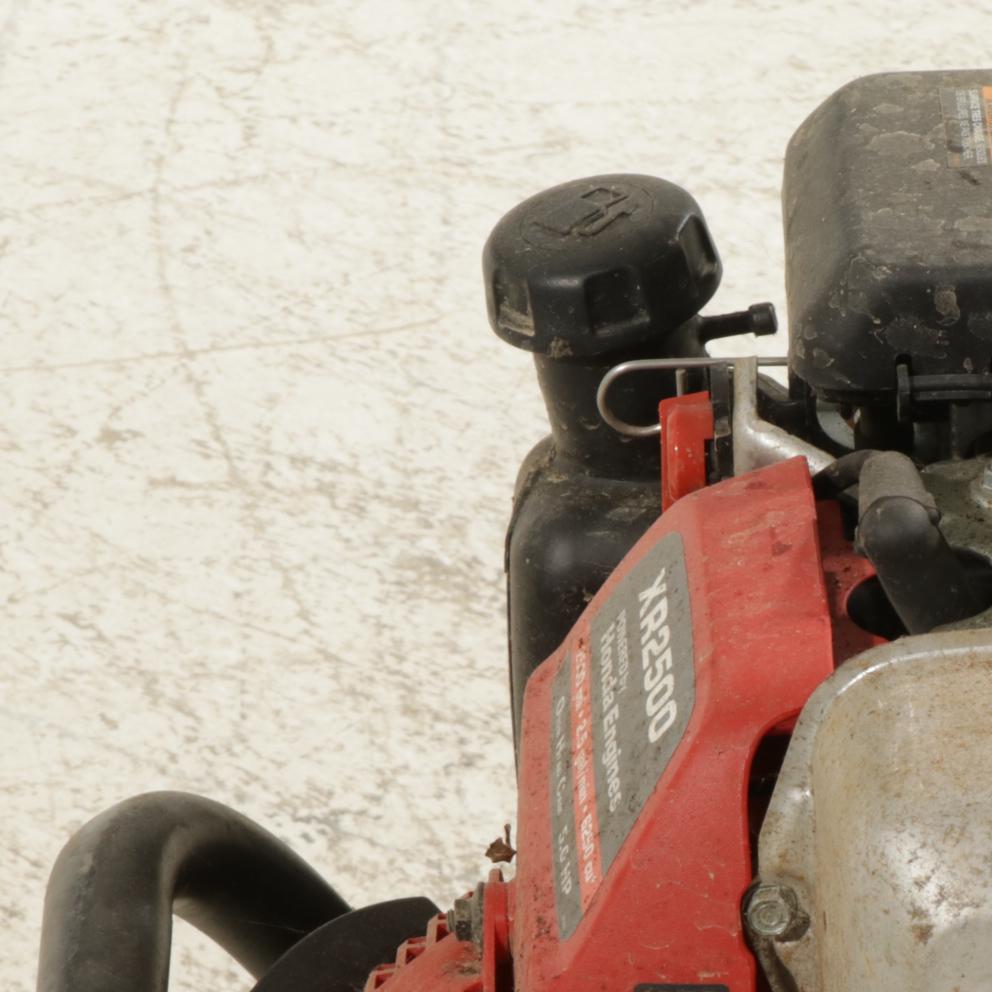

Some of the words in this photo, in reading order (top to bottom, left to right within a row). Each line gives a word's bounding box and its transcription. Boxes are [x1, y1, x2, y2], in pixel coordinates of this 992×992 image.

[601, 623, 619, 713] Honda
[638, 567, 678, 743] XR2500
[602, 704, 622, 812] Engines
